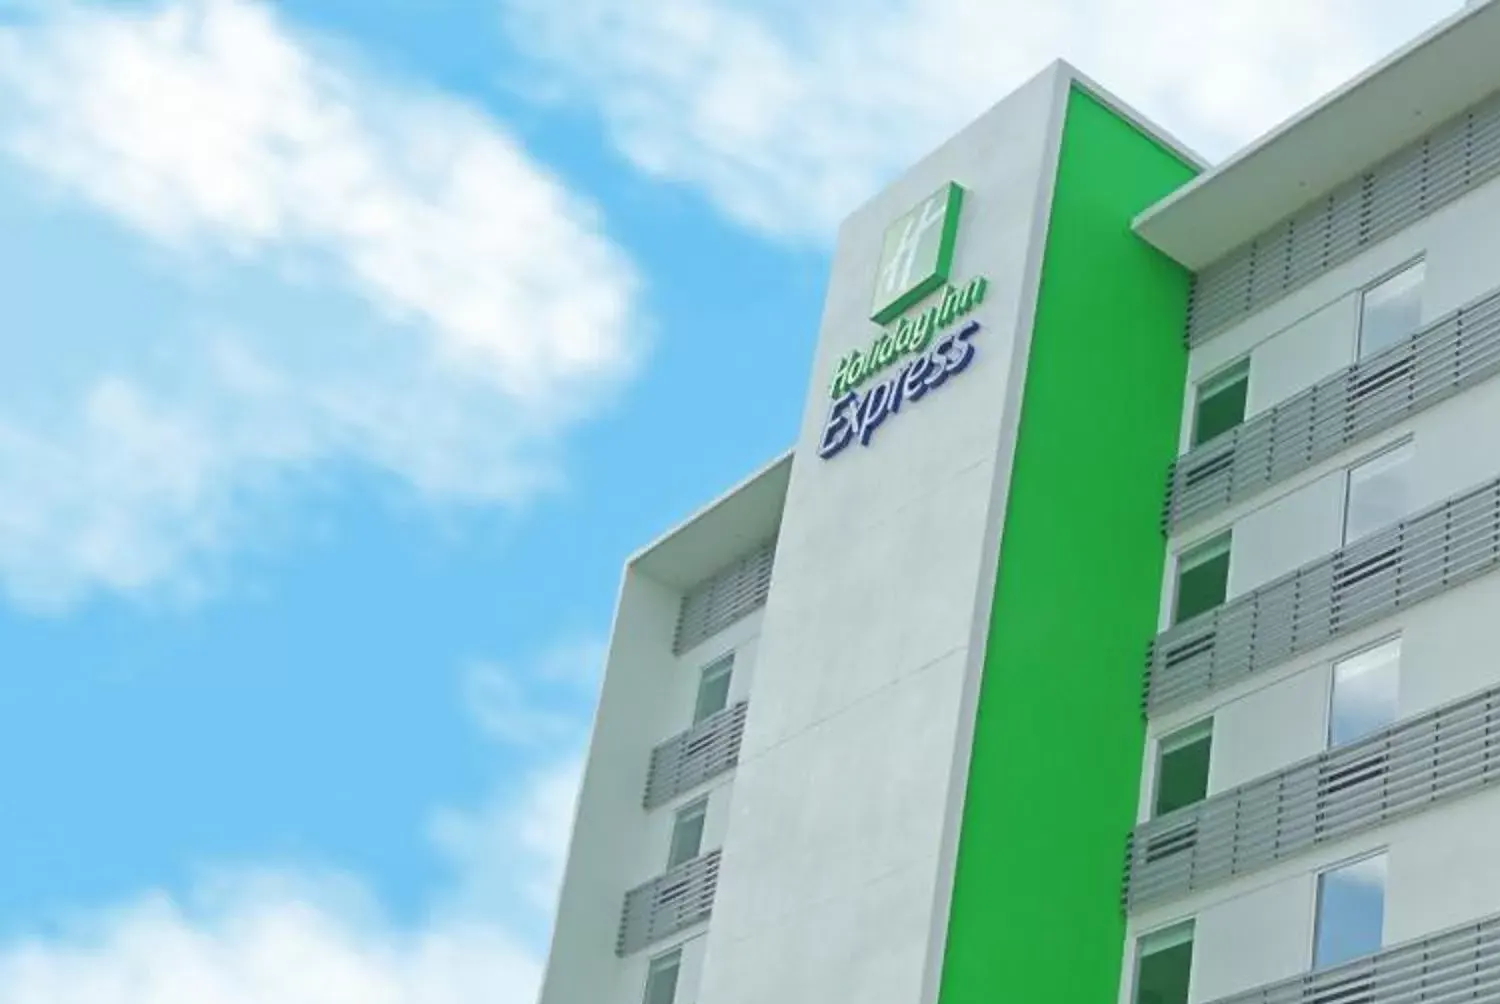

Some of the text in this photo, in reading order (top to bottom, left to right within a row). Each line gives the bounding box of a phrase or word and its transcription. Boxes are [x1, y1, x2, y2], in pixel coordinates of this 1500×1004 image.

[819, 319, 981, 460] Express
[829, 276, 988, 400] Holiday Inn
